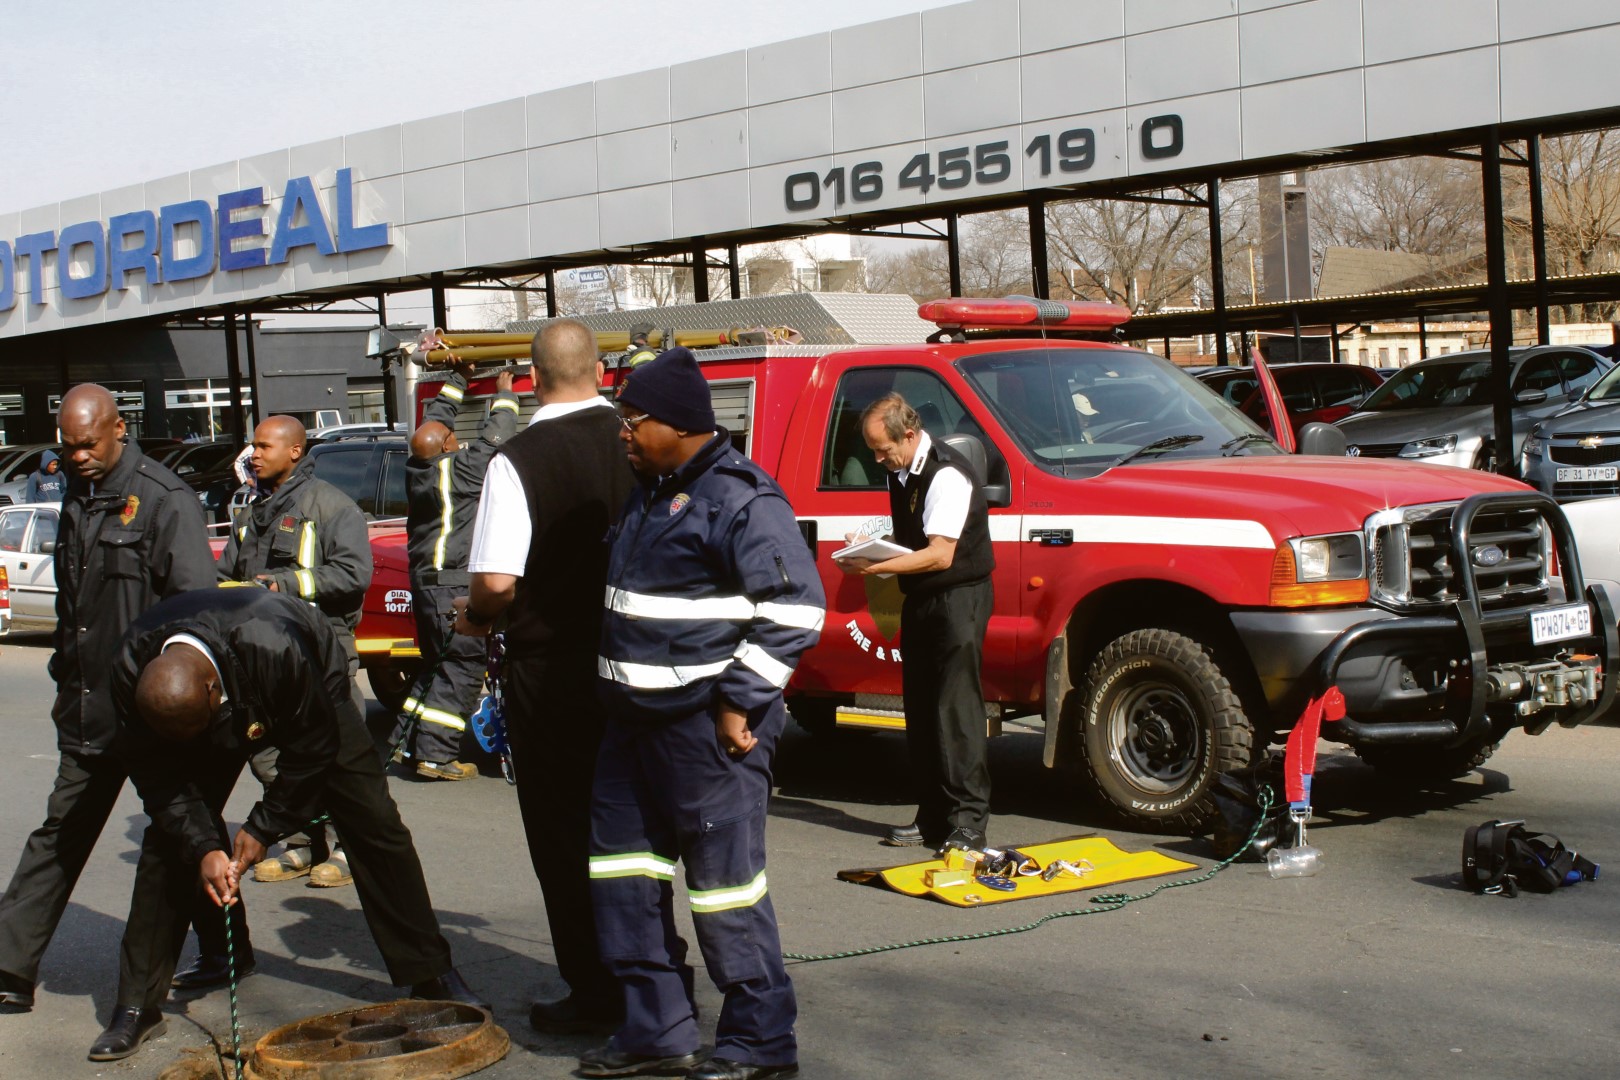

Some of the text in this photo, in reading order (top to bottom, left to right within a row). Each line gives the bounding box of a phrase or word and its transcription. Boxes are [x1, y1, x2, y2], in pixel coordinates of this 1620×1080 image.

[784, 161, 883, 213] 016
[899, 140, 1011, 192] 455
[1025, 128, 1095, 175] 19
[1573, 469, 1582, 480] 31
[1605, 468, 1616, 479] GP
[846, 619, 872, 652] FIRE
[876, 646, 885, 660] &
[1578, 610, 1588, 631] GP
[1089, 660, 1151, 725] BFGoodrich
